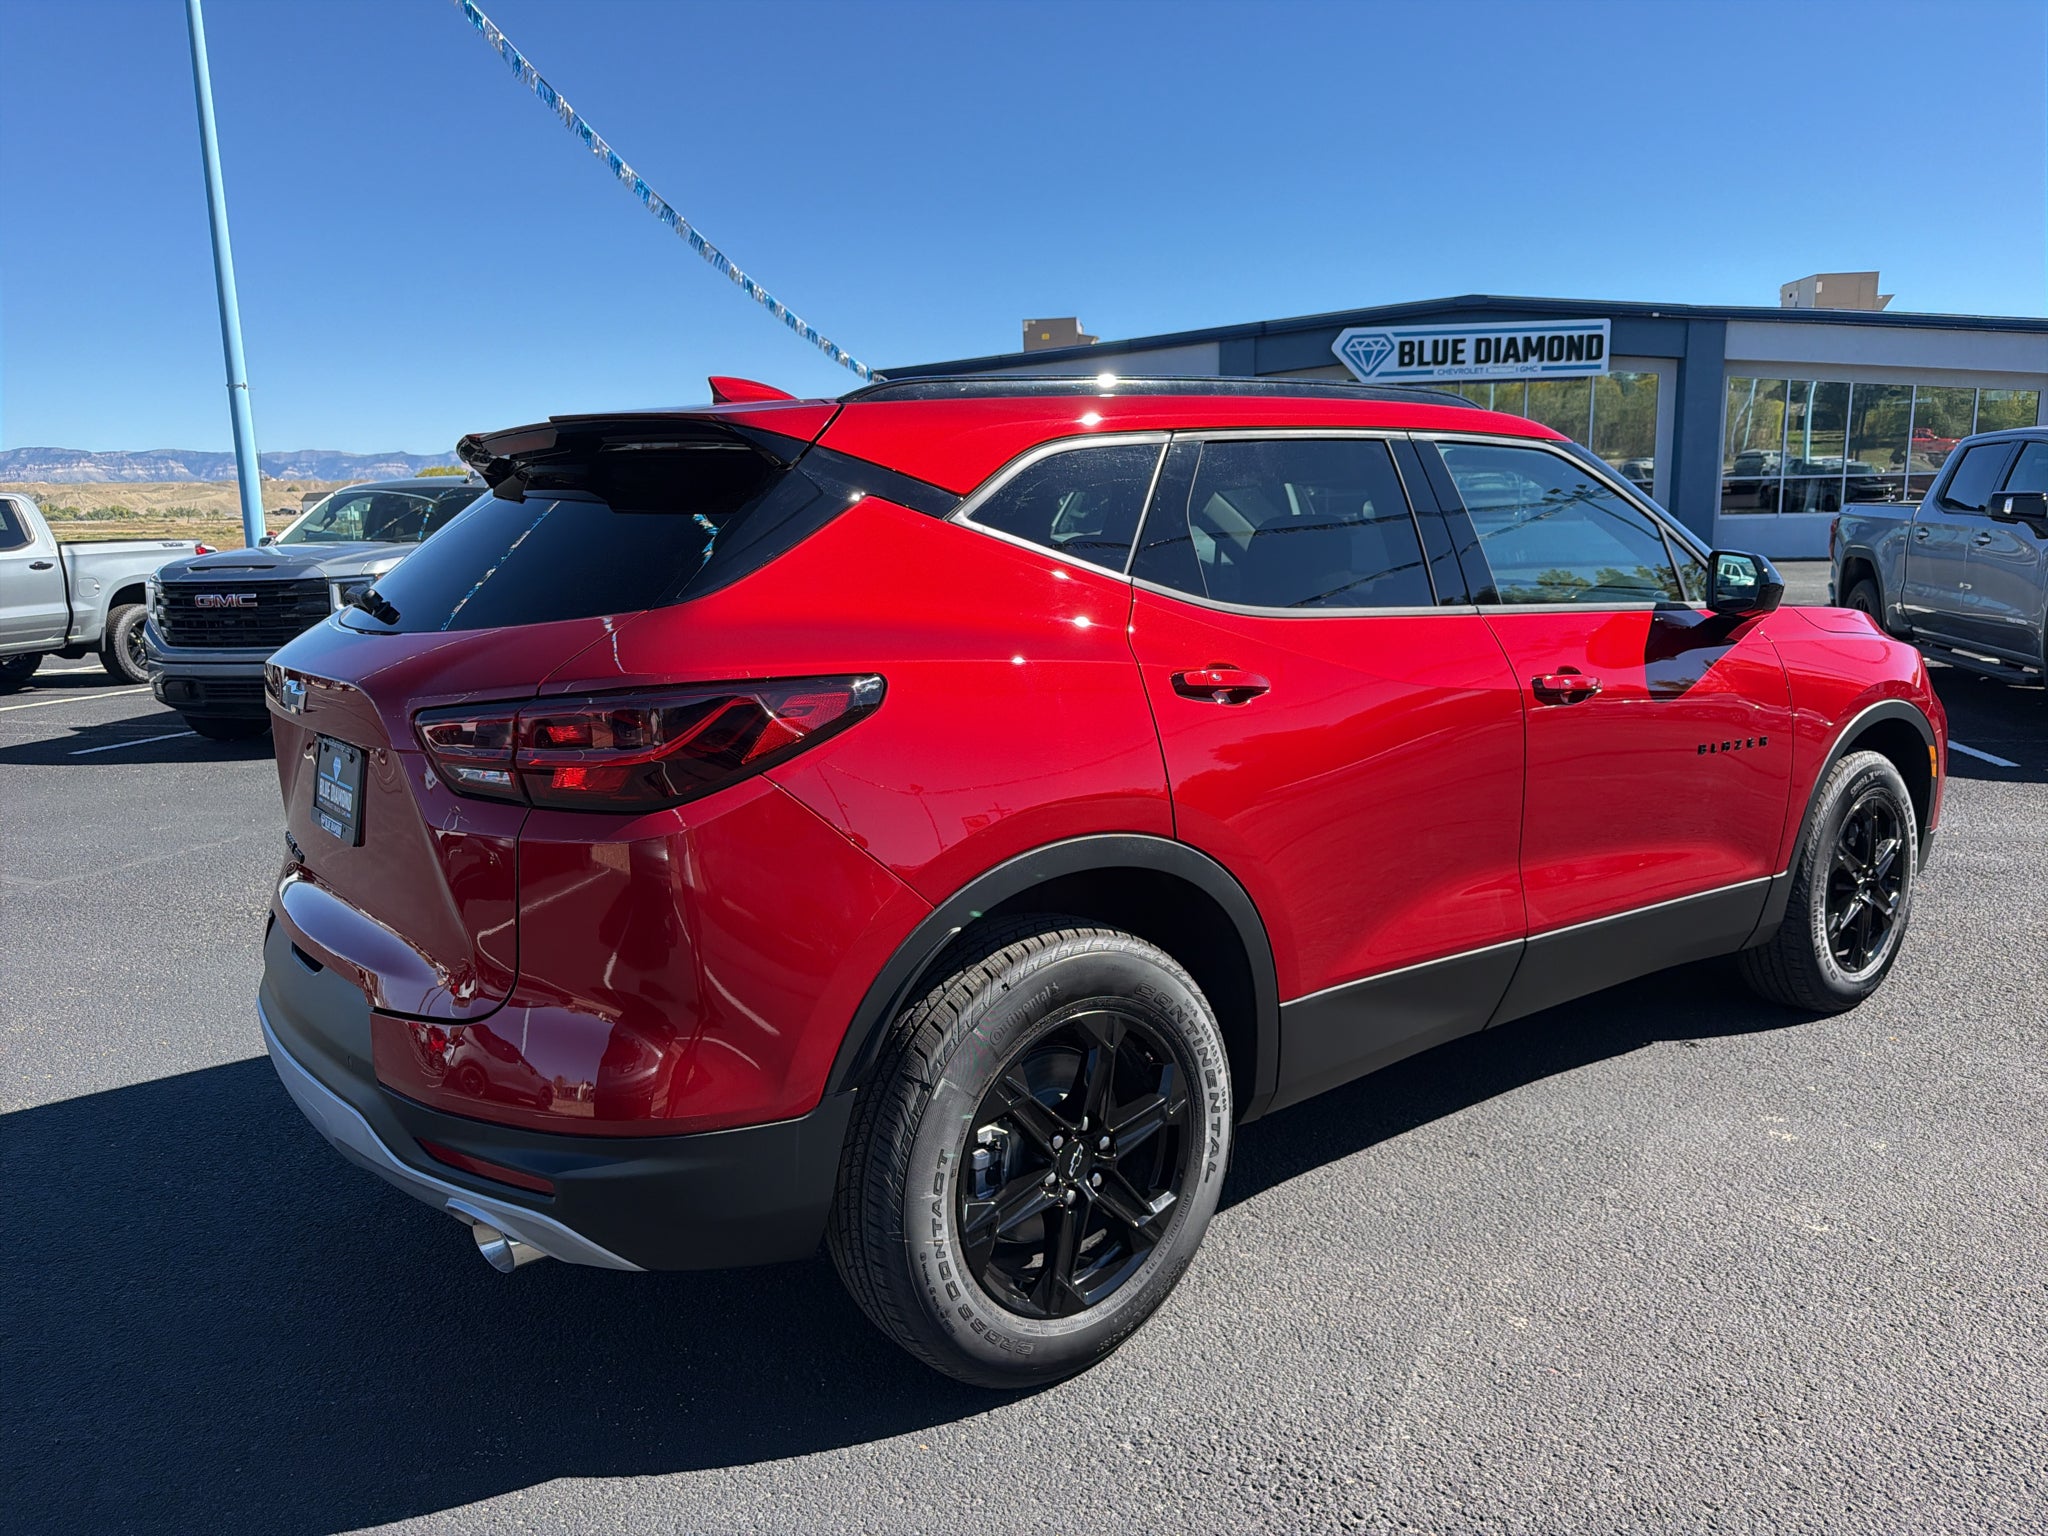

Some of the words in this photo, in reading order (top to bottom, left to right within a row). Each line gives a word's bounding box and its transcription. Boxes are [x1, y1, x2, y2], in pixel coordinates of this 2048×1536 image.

[1398, 338, 1467, 368] BLUE
[1474, 333, 1605, 365] DIAMOND
[1437, 367, 1484, 376] CHEVROLET
[1520, 365, 1539, 373] GMC
[195, 593, 258, 608] GMC
[1697, 736, 1768, 755] BLAZER
[1134, 982, 1221, 1184] CONTINENTAL
[931, 1148, 962, 1302] CONTACT
[957, 1302, 1036, 1357] CROSS
